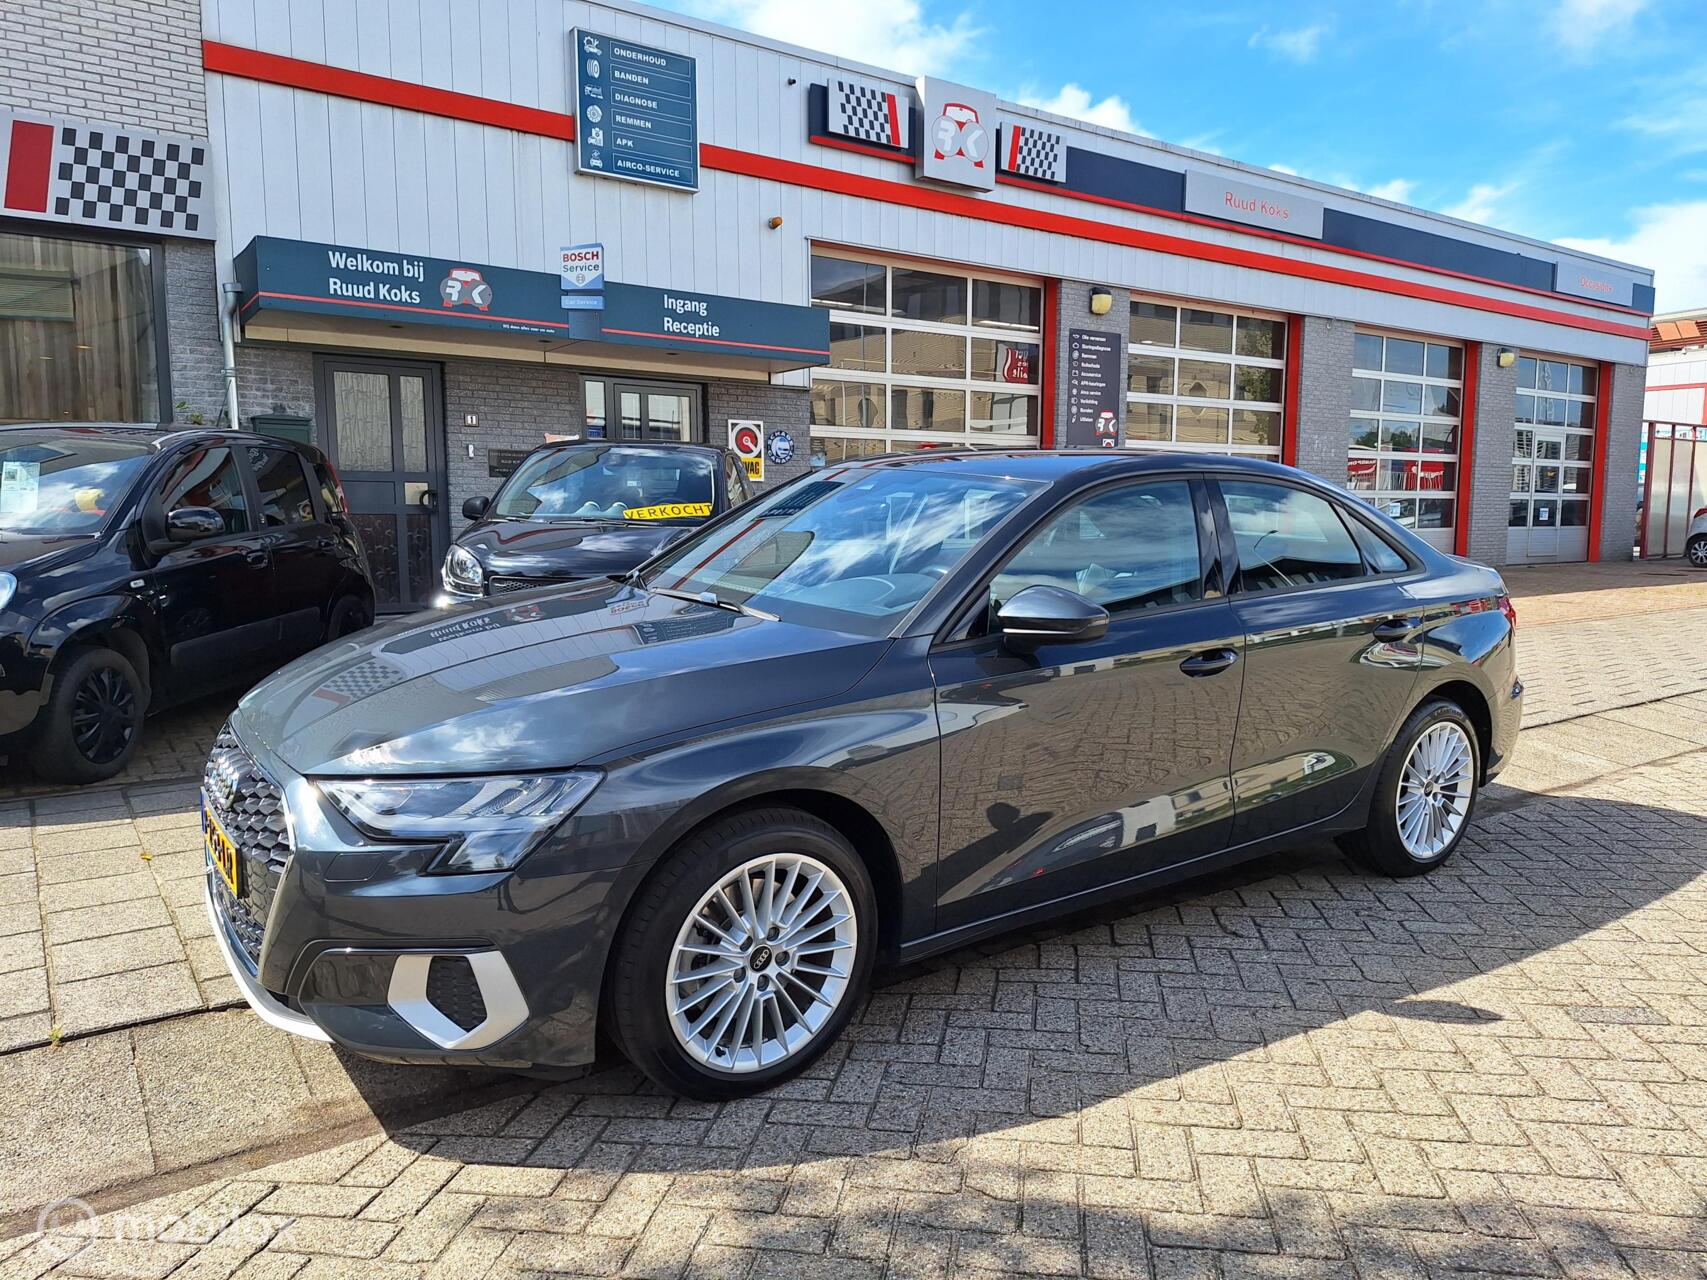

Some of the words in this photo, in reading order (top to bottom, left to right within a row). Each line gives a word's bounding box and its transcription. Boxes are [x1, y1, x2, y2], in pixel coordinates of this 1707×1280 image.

[614, 47, 667, 67] ONDERHOUD
[614, 70, 649, 85] BANDEN
[615, 93, 658, 109] DIAGNOSE
[615, 115, 652, 129] REMMEN
[616, 138, 634, 148] APK
[617, 159, 680, 178] AIRCO-SERVICE
[1225, 191, 1256, 212] Ruud
[1260, 204, 1289, 220] Koks
[562, 250, 600, 263] BOSCH
[328, 250, 399, 276] Welkom
[403, 261, 425, 282] bij
[562, 262, 600, 273] Service
[328, 277, 374, 300] Ruud
[379, 283, 421, 305] Koks
[663, 294, 707, 317] Ingang
[663, 317, 720, 339] Receptie
[768, 431, 793, 445] SCHADE
[624, 504, 713, 519] VERKOCHT
